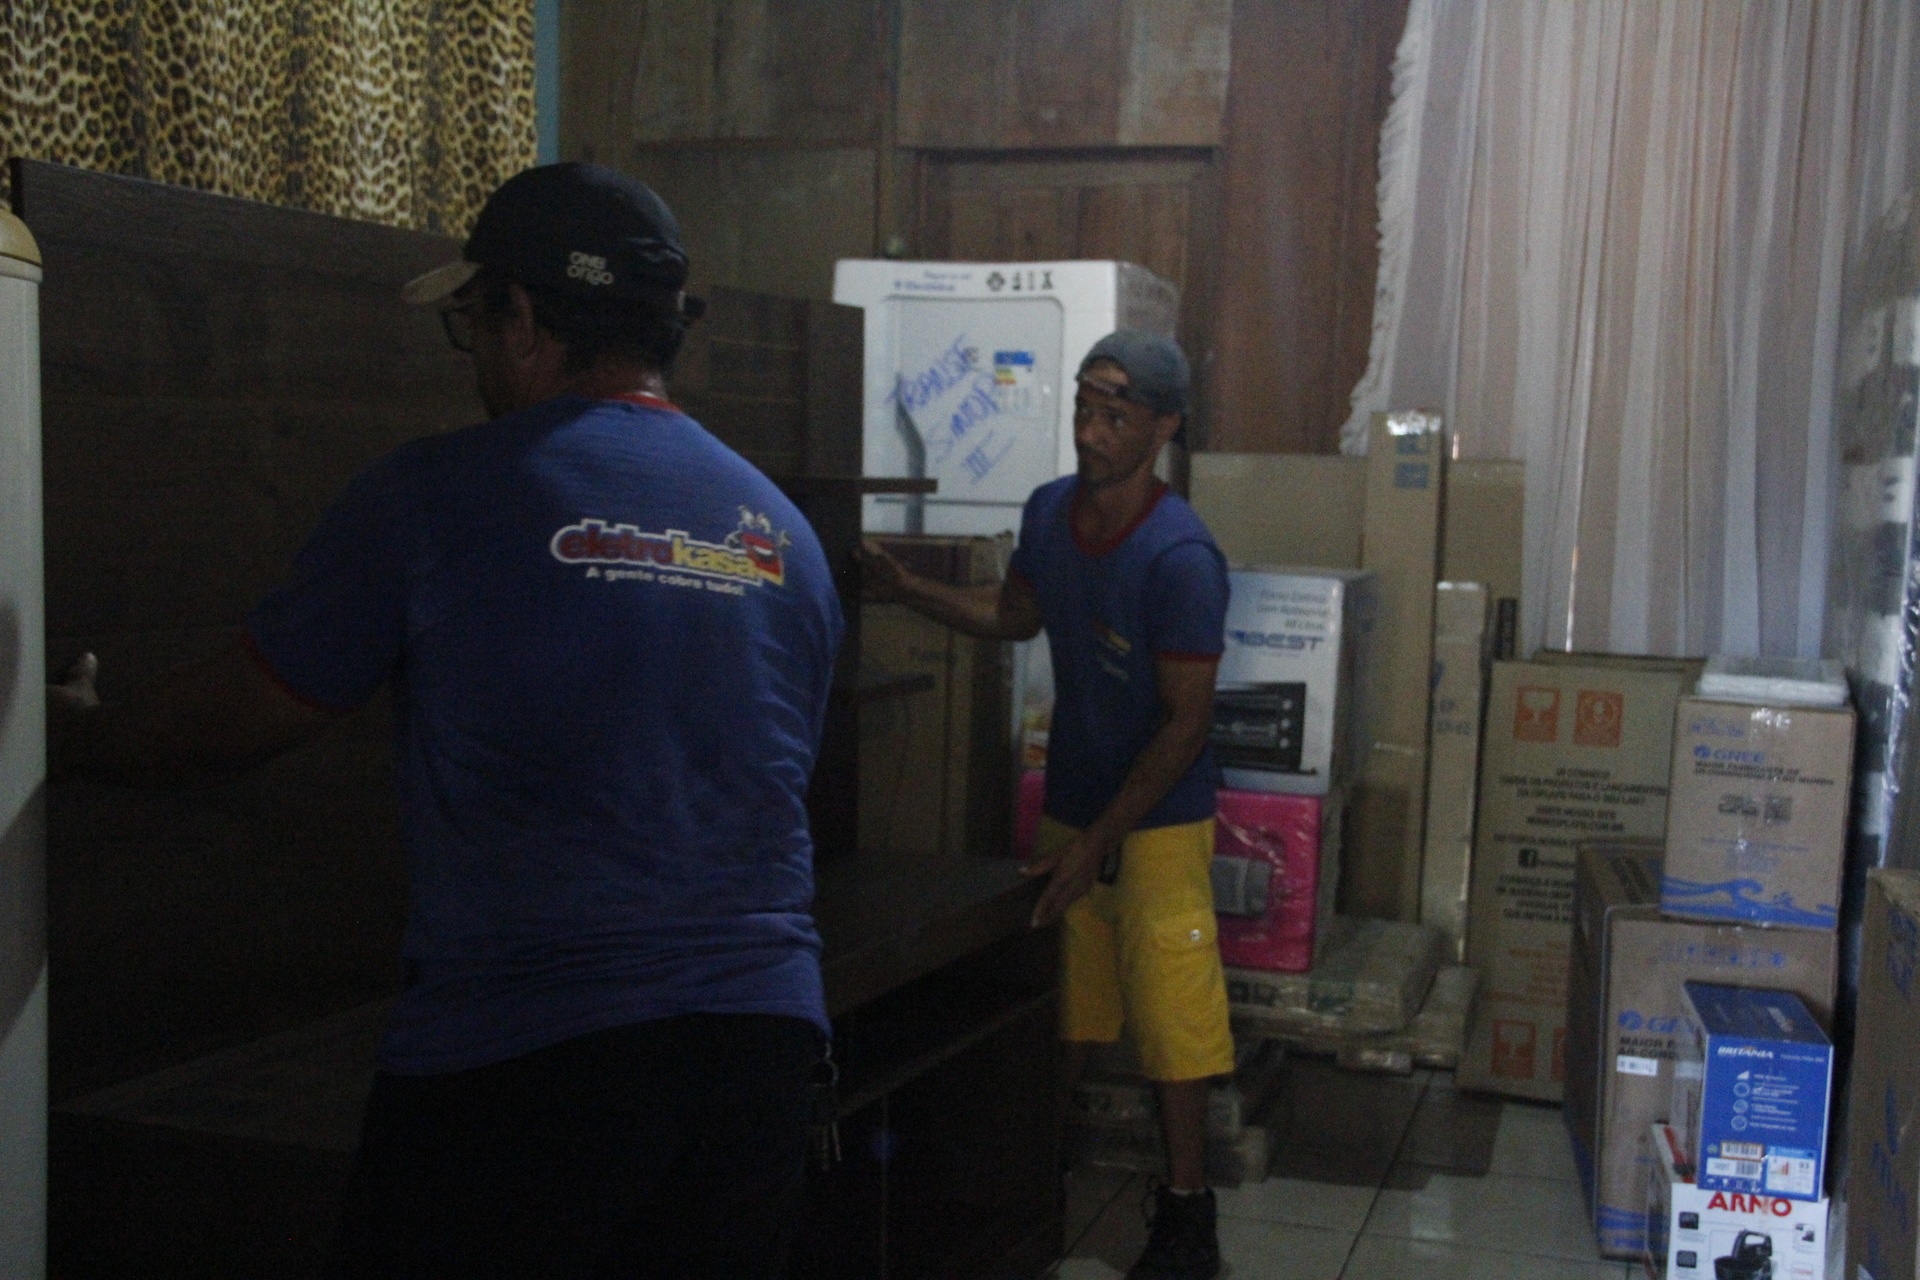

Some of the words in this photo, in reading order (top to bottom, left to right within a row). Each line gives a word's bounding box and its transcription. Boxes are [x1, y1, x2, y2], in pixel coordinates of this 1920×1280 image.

[585, 565, 601, 579] A
[603, 568, 655, 582] gente
[1707, 1191, 1792, 1217] ARNO
